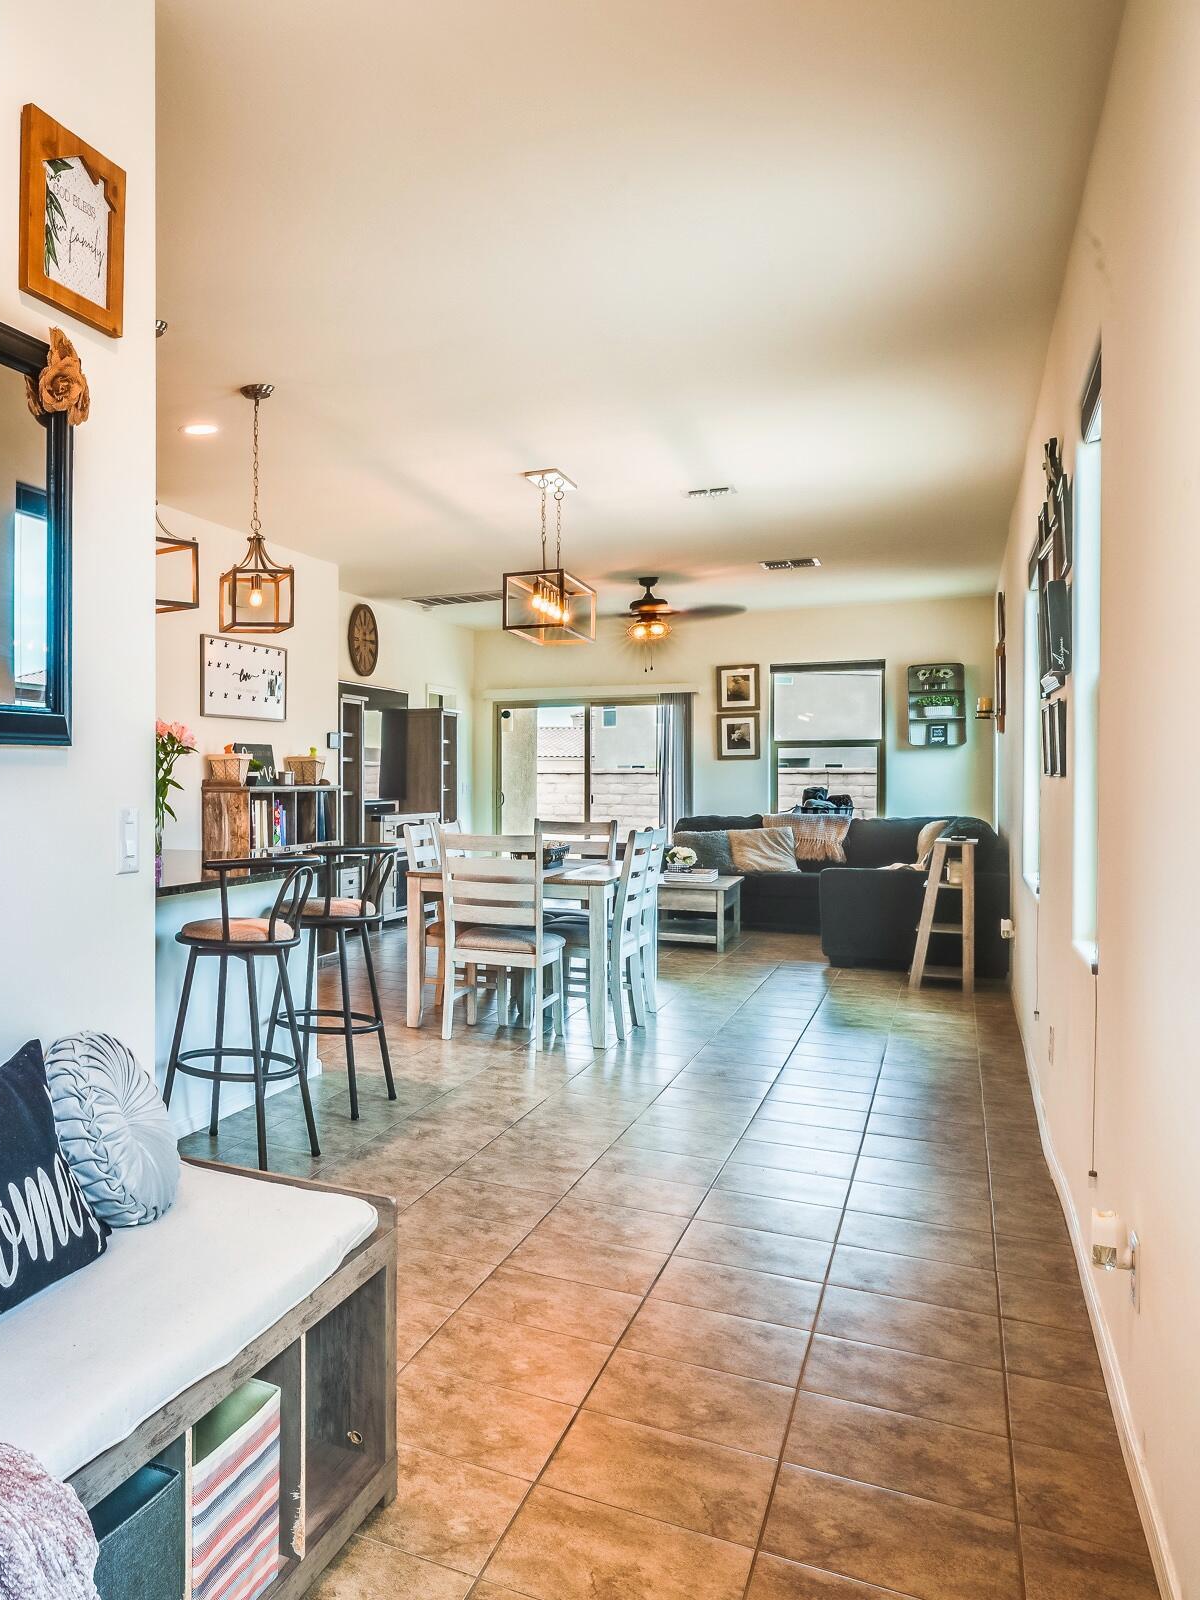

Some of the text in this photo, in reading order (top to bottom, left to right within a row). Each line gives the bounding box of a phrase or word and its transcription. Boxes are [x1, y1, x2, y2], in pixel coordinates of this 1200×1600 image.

[52, 182, 97, 221] GOD BLESS
[68, 226, 105, 279] family
